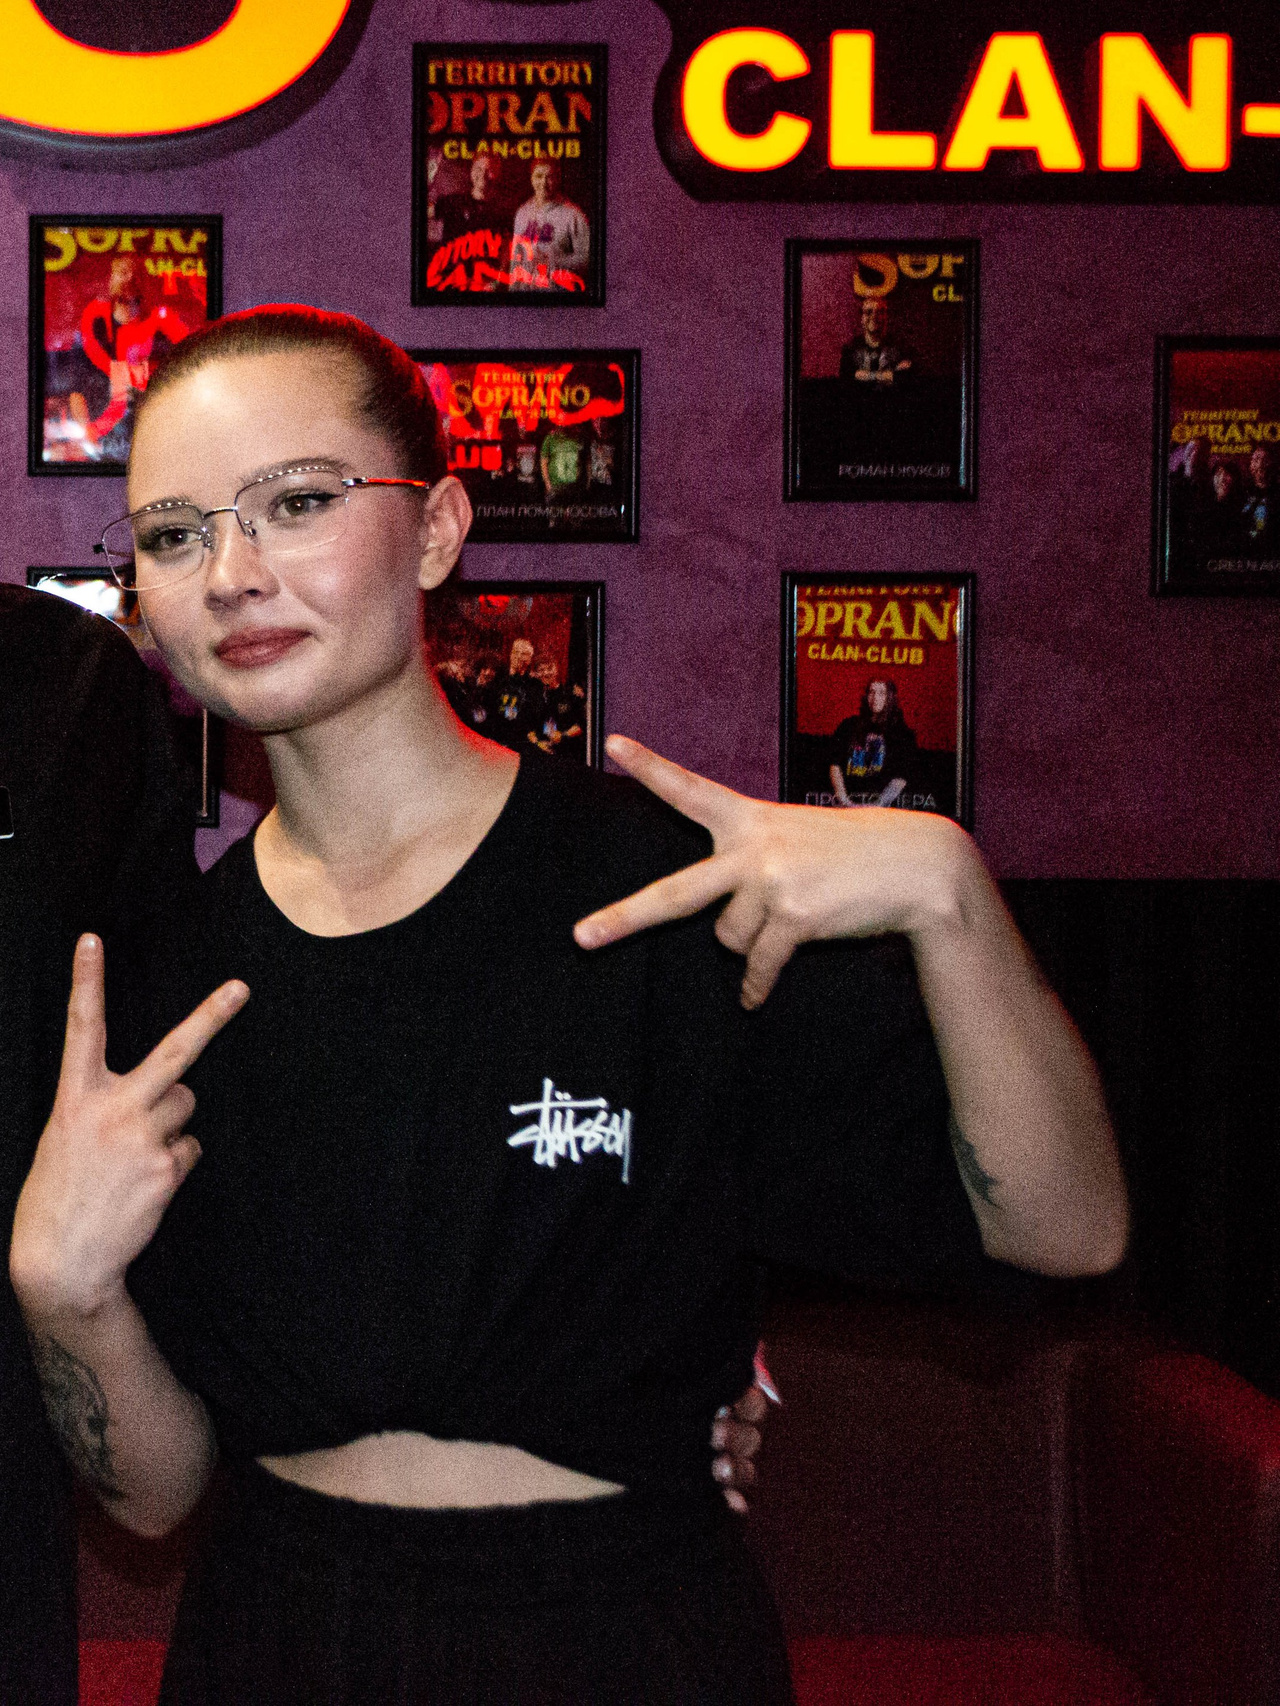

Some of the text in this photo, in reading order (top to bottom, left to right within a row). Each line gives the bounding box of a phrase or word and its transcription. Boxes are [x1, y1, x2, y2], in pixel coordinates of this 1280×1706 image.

[681, 26, 1280, 172] CLAN-
[443, 139, 581, 159] CLAN-CLUB
[448, 379, 590, 419] SOPRANO
[797, 600, 959, 641] OPRAN
[807, 643, 924, 665] CLAN-CLUB
